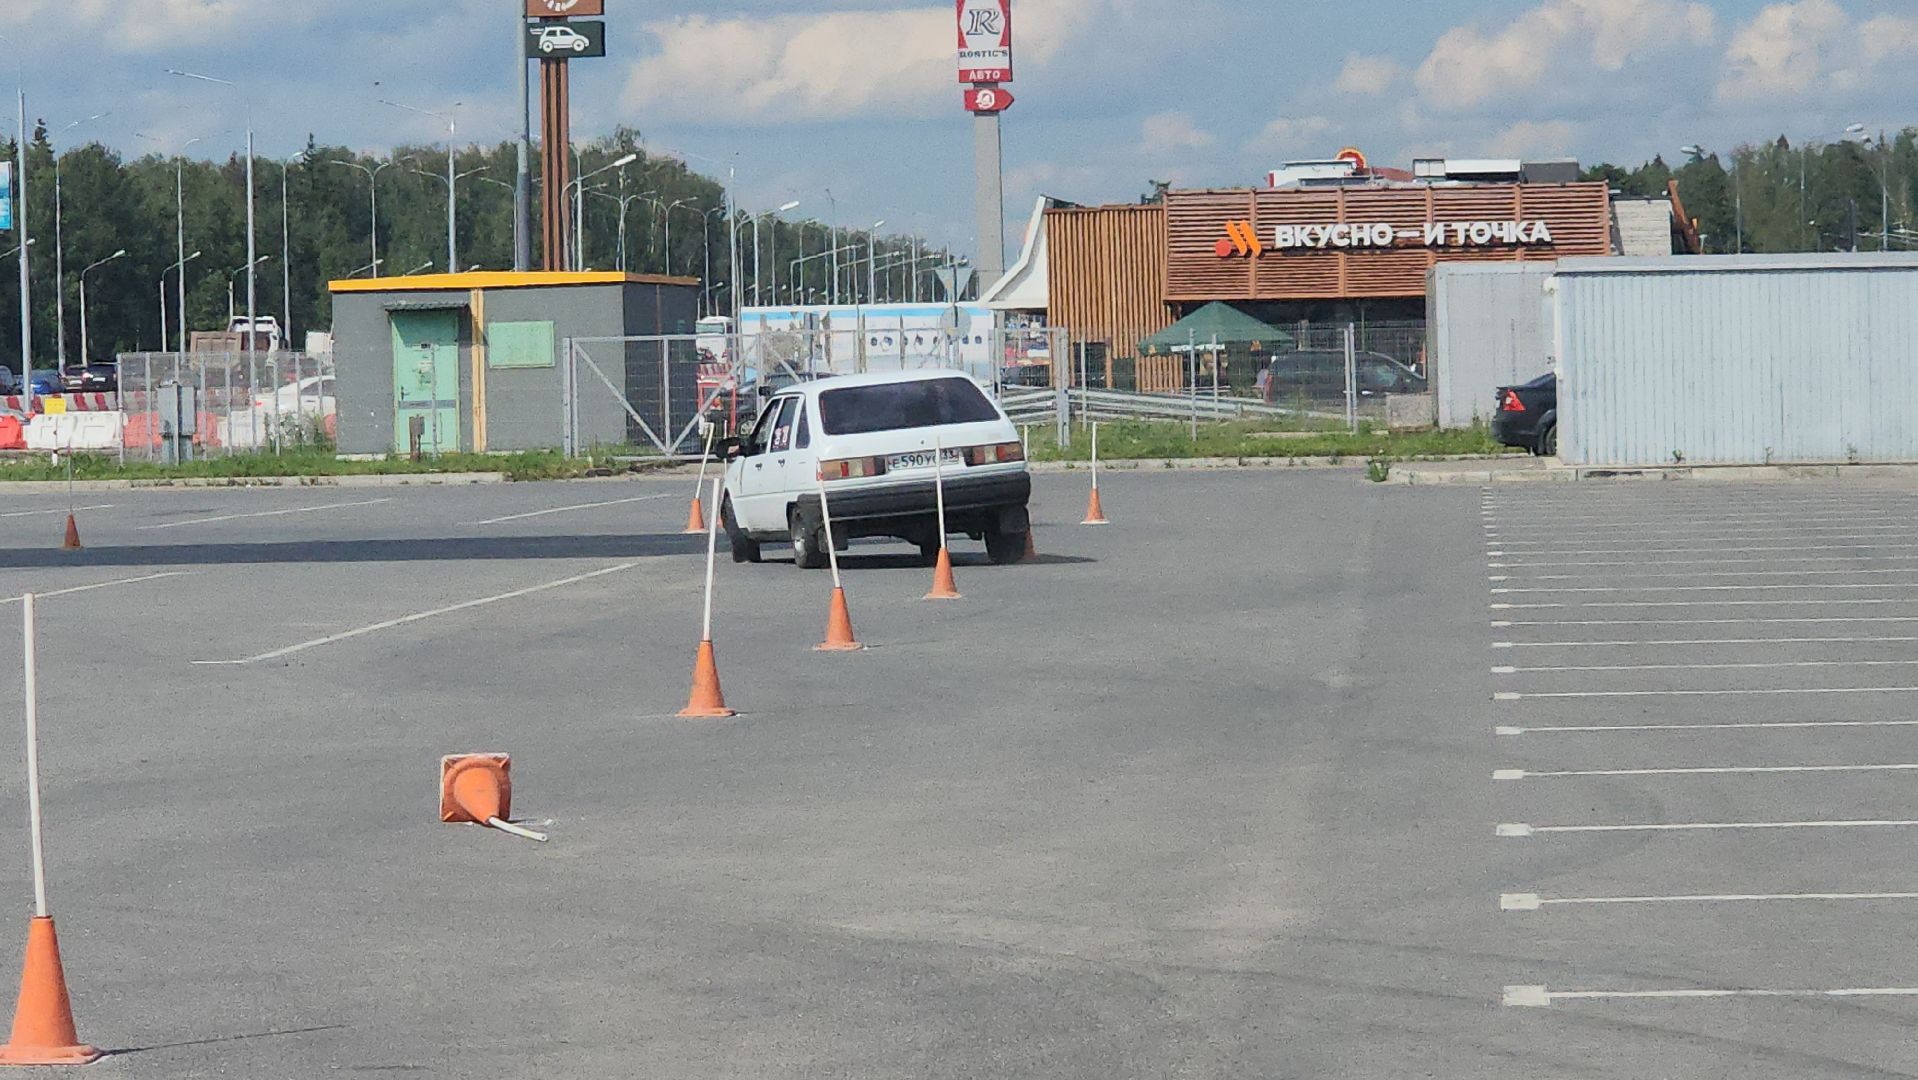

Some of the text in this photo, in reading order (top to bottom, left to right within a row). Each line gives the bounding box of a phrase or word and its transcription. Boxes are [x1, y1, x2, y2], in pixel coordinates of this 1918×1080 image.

[969, 69, 1001, 80] АВТО
[1275, 223, 1393, 248] ВКУСНО
[1451, 220, 1552, 245] ТОЧКА
